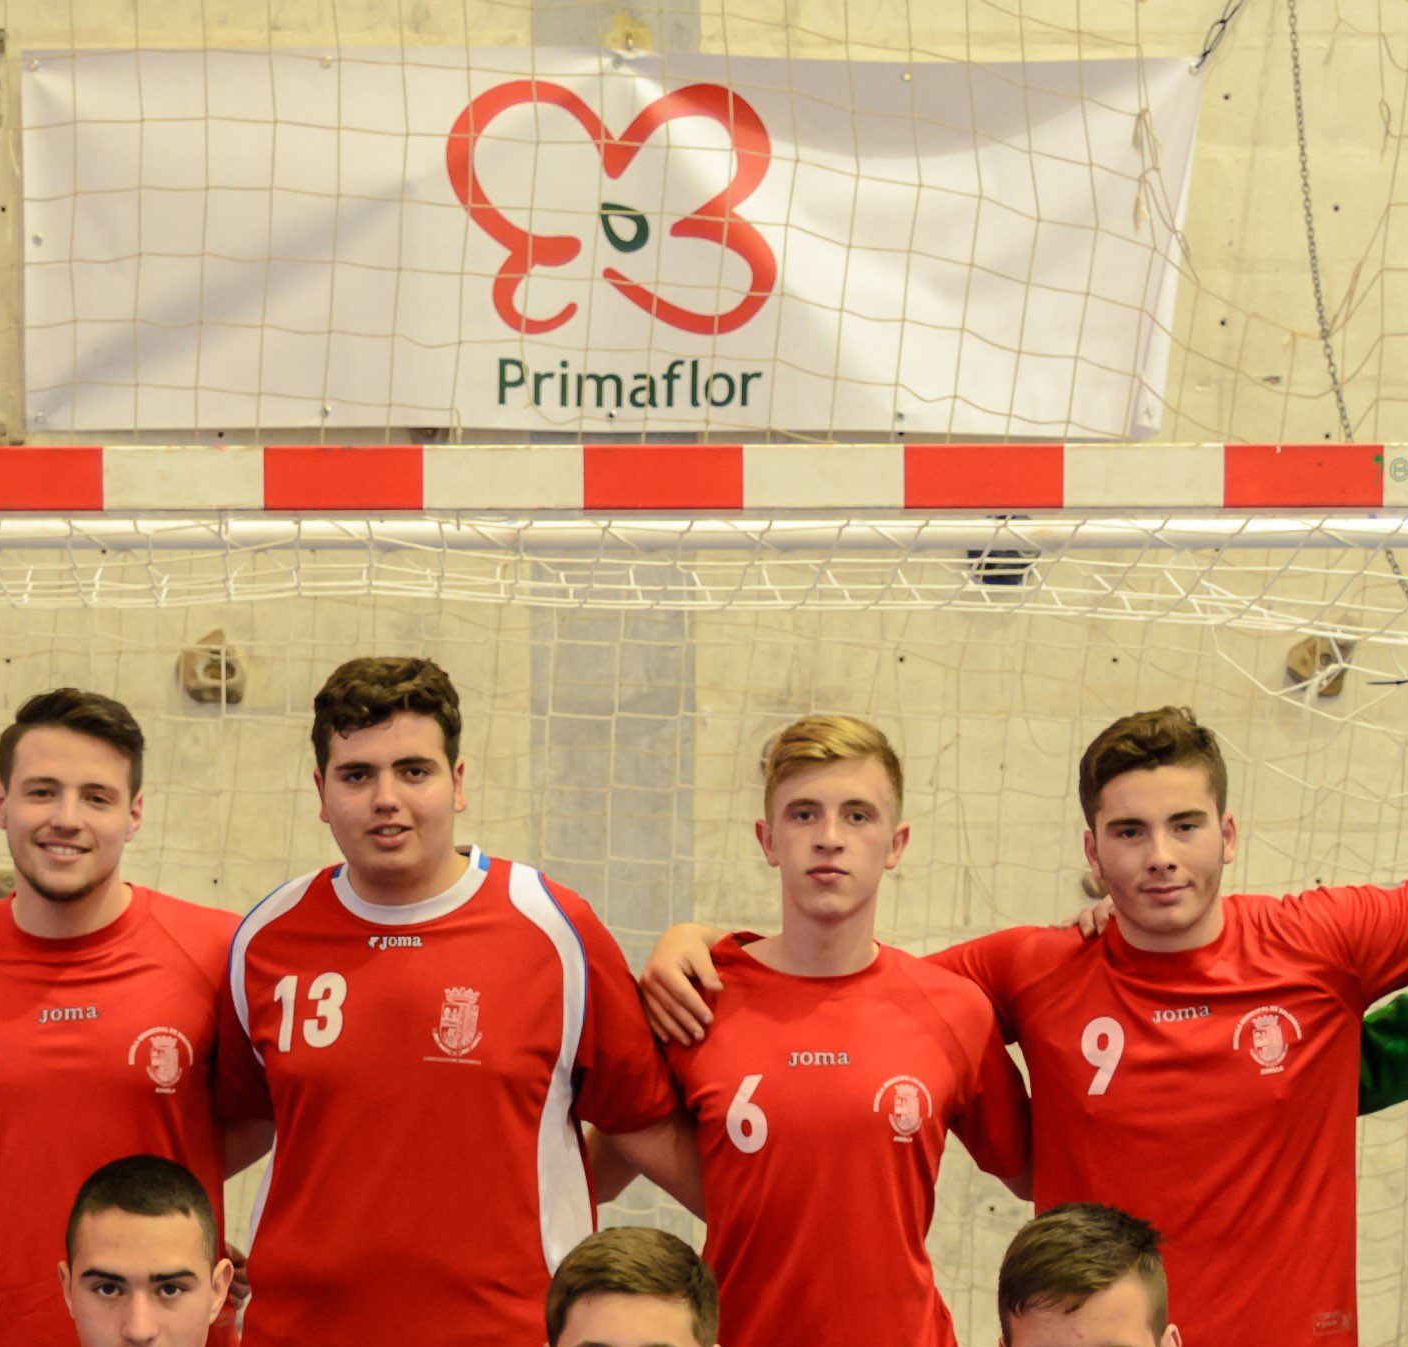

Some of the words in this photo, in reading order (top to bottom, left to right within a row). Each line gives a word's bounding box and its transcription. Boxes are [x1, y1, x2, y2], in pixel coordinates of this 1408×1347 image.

[497, 356, 763, 410] Primaflor
[273, 971, 348, 1053] 13
[1080, 1016, 1125, 1096] 9
[726, 1074, 768, 1154] 6
